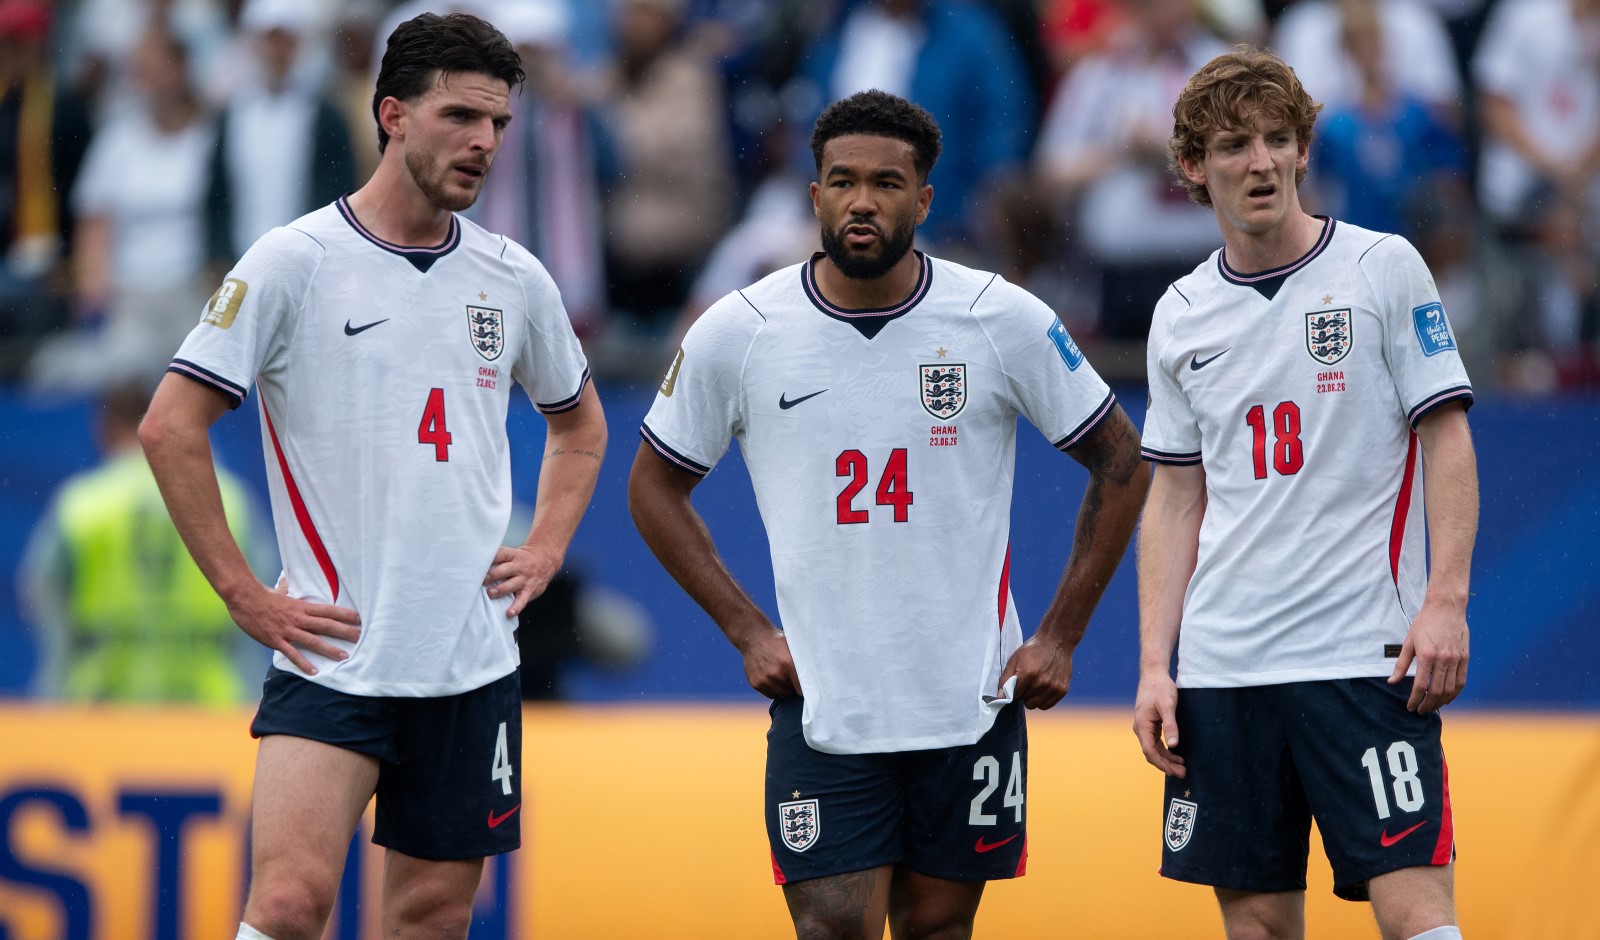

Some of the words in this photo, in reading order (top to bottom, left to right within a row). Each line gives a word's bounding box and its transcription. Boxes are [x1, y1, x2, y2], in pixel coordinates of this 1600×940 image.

[1317, 371, 1344, 381] GHANA
[1317, 382, 1346, 393] 23.06.26
[418, 387, 452, 462] 4
[929, 437, 958, 446] 23.06.26
[931, 425, 957, 435] GHANA
[1246, 400, 1304, 480] 18
[836, 448, 914, 525] 24
[491, 722, 513, 796] 4
[969, 751, 1024, 826] 24
[1361, 740, 1425, 820] 18
